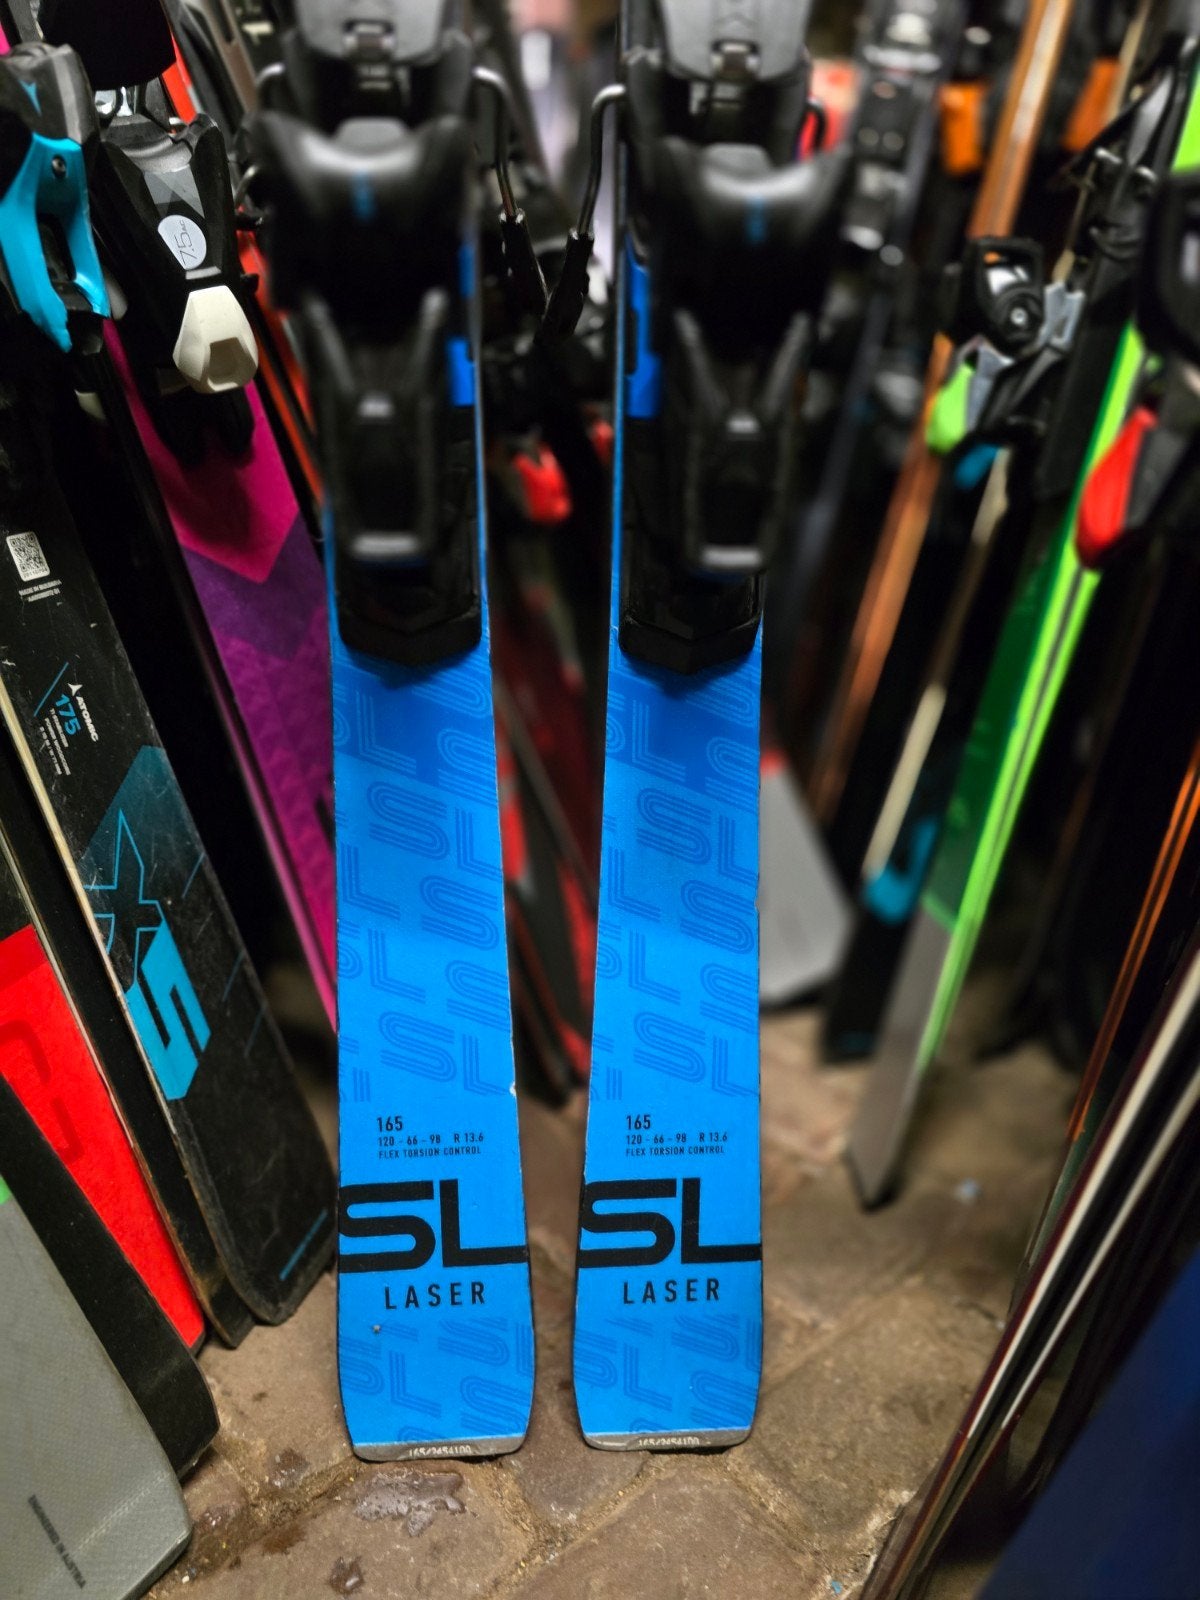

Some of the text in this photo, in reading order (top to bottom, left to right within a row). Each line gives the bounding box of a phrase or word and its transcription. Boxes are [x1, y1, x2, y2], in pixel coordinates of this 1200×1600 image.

[55, 694, 81, 735] 175
[76, 696, 98, 742] ATOMIC
[376, 1115, 403, 1132] 165
[626, 1114, 651, 1130] 165
[378, 1135, 395, 1147] 120
[407, 1135, 418, 1146] 66
[429, 1134, 441, 1144] 98
[453, 1133, 460, 1143] R
[464, 1132, 484, 1143] 13.6
[626, 1135, 642, 1145] 120
[653, 1134, 664, 1144] 66
[675, 1132, 687, 1143] 98
[699, 1132, 705, 1143] R
[709, 1131, 728, 1142] 13.6
[379, 1146, 482, 1159] FLEX TORSION CONTROL
[625, 1145, 724, 1157] FLEX TORSION CONTROL
[338, 1179, 529, 1273] SL
[578, 1177, 762, 1269] SL
[384, 1281, 486, 1309] LASER
[623, 1278, 720, 1305] LASER
